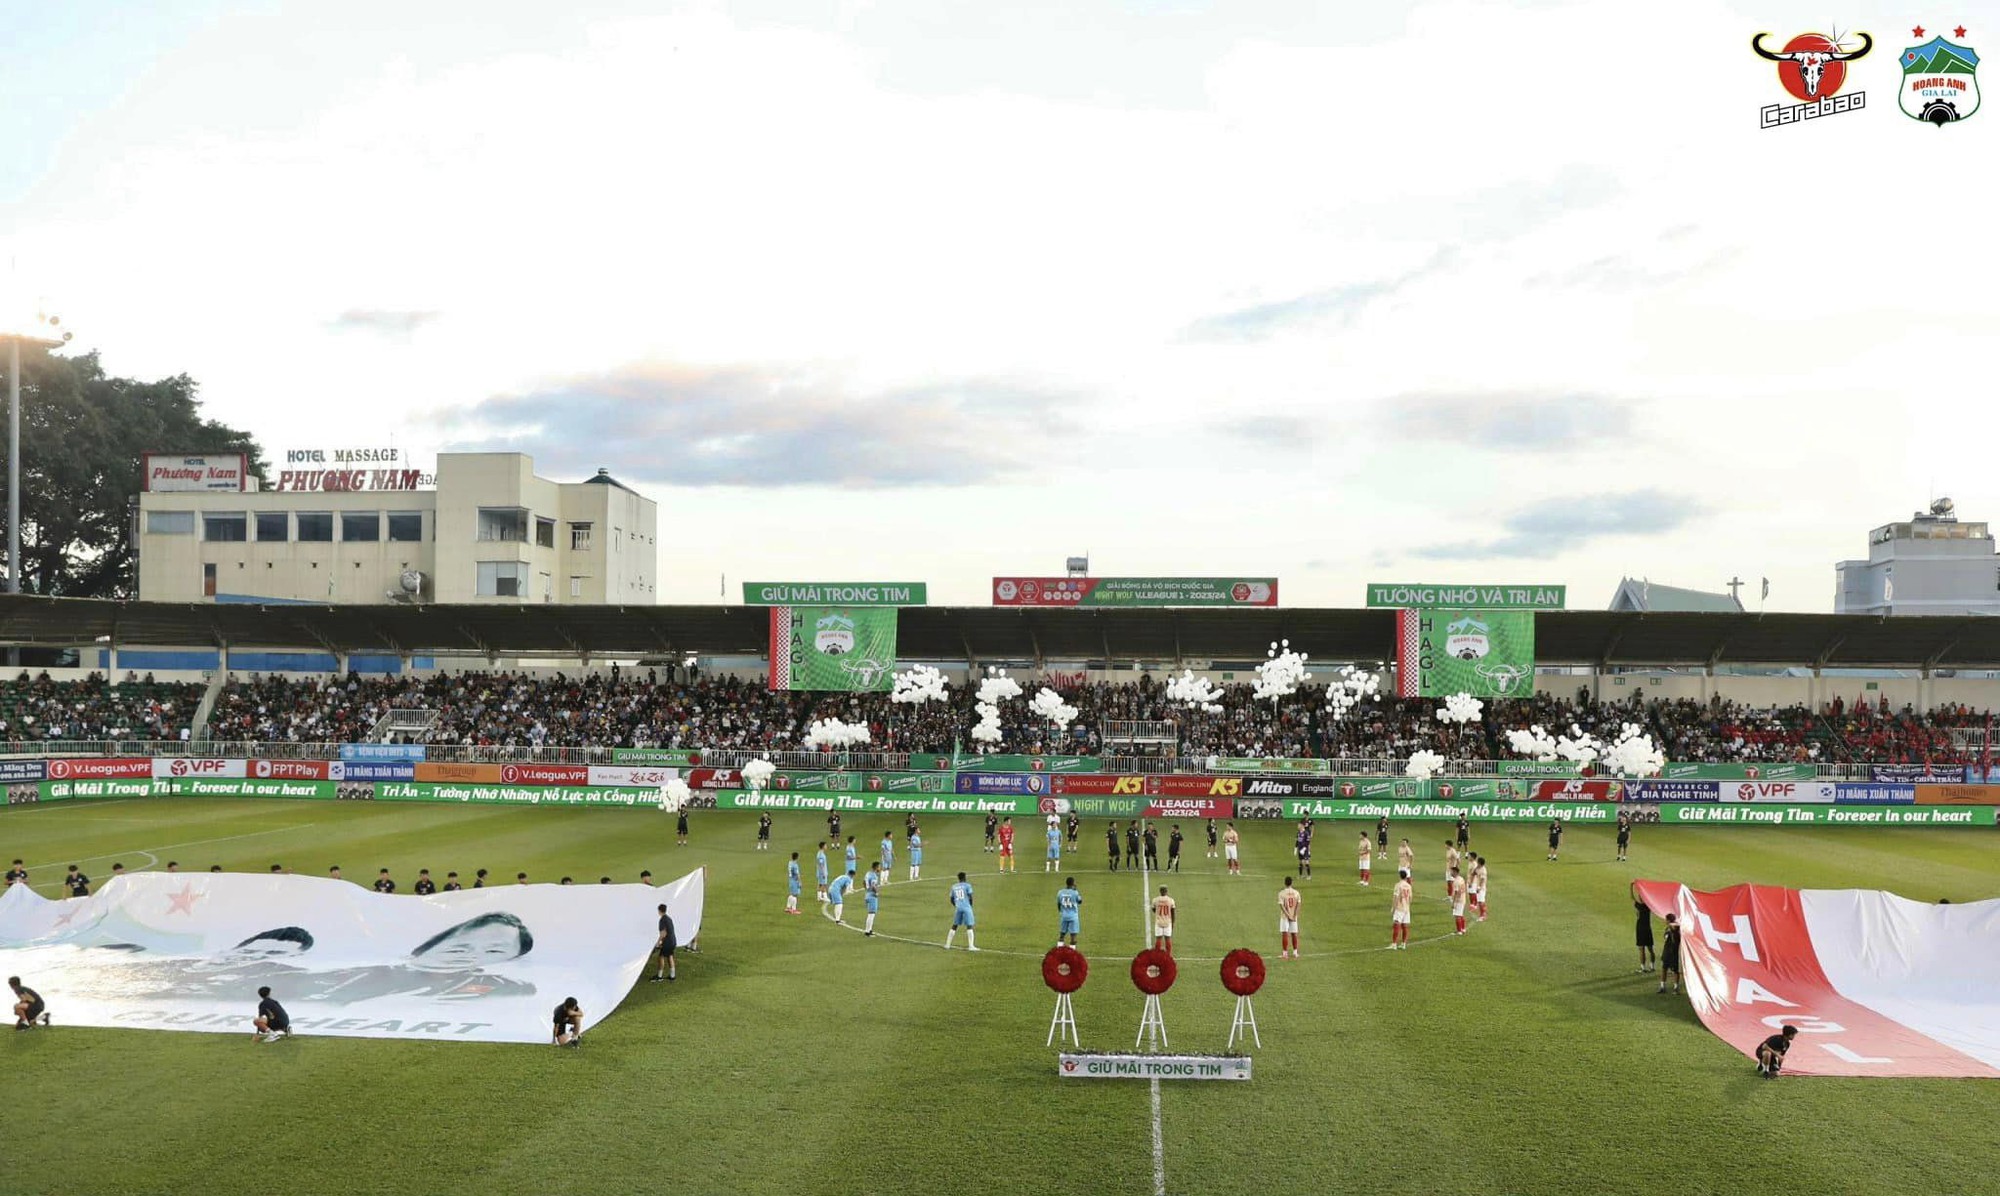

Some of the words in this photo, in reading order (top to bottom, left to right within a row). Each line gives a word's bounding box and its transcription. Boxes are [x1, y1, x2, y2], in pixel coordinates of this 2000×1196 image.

[287, 450, 326, 462] HOTEL
[335, 448, 398, 461] MASSAGE
[207, 467, 237, 478] Nam
[369, 469, 420, 490] NAM
[761, 585, 789, 601] GIỮ
[792, 585, 820, 601] MÃI
[824, 587, 878, 601] TRONG
[881, 587, 910, 601] TIM
[1135, 591, 1178, 599] V.LEAGUE
[1190, 591, 1226, 600] 2023/24
[1481, 588, 1504, 604] VÀ
[1507, 589, 1531, 604] TRI
[74, 763, 150, 775] V.League.VPF
[191, 760, 226, 772] VPF
[273, 764, 293, 775] FPT
[295, 765, 319, 778] Play
[522, 769, 587, 782] V.League.VPF
[74, 782, 102, 796] Mãi
[107, 781, 149, 797] Trong
[153, 780, 181, 795] Tim
[192, 782, 238, 794] Forever
[241, 781, 255, 793] in
[257, 785, 279, 795] our
[281, 783, 317, 795] heart
[1112, 777, 1144, 794] K5
[1209, 778, 1241, 795] K5
[1247, 780, 1292, 794] Mitre
[1303, 784, 1334, 792] England
[1758, 783, 1796, 796] VPF
[383, 785, 399, 797] Tri
[400, 783, 418, 797] Ân
[562, 789, 584, 803] Lực
[586, 789, 600, 800] và
[603, 788, 635, 804] Cống
[1642, 791, 1659, 799] BIA
[762, 794, 789, 807] Mãi
[793, 795, 834, 810] Trong
[838, 796, 864, 808] Tim
[876, 797, 929, 809] Forever
[932, 797, 948, 810] in
[950, 800, 974, 811] our
[977, 799, 1016, 811] heart
[1074, 801, 1105, 812] NIGHT
[1108, 801, 1136, 812] WOLF
[1149, 799, 1206, 809] V.LEAGUE
[1208, 800, 1215, 808] 1
[1162, 809, 1200, 817] 2023/24
[1292, 803, 1311, 815] Tri
[1312, 800, 1331, 815] Ân
[1470, 803, 1490, 817] Nỗ
[1493, 805, 1516, 820] Lực
[1519, 806, 1534, 817] và
[1538, 805, 1572, 820] Cống
[1574, 805, 1606, 819] Hiến
[1679, 807, 1706, 820] Giữ
[1708, 808, 1737, 820] Mãi
[1740, 808, 1783, 823] Trong
[1787, 809, 1814, 821] Tim
[1827, 809, 1883, 822] Forever
[1885, 809, 1900, 822] in
[1903, 812, 1929, 822] our
[1931, 809, 1973, 822] heart
[288, 1017, 493, 1034] HEART
[1087, 1060, 1111, 1074] GIỮ
[1116, 1061, 1142, 1074] MÃI
[1145, 1063, 1194, 1076] TRONG
[1197, 1065, 1222, 1076] TIM
